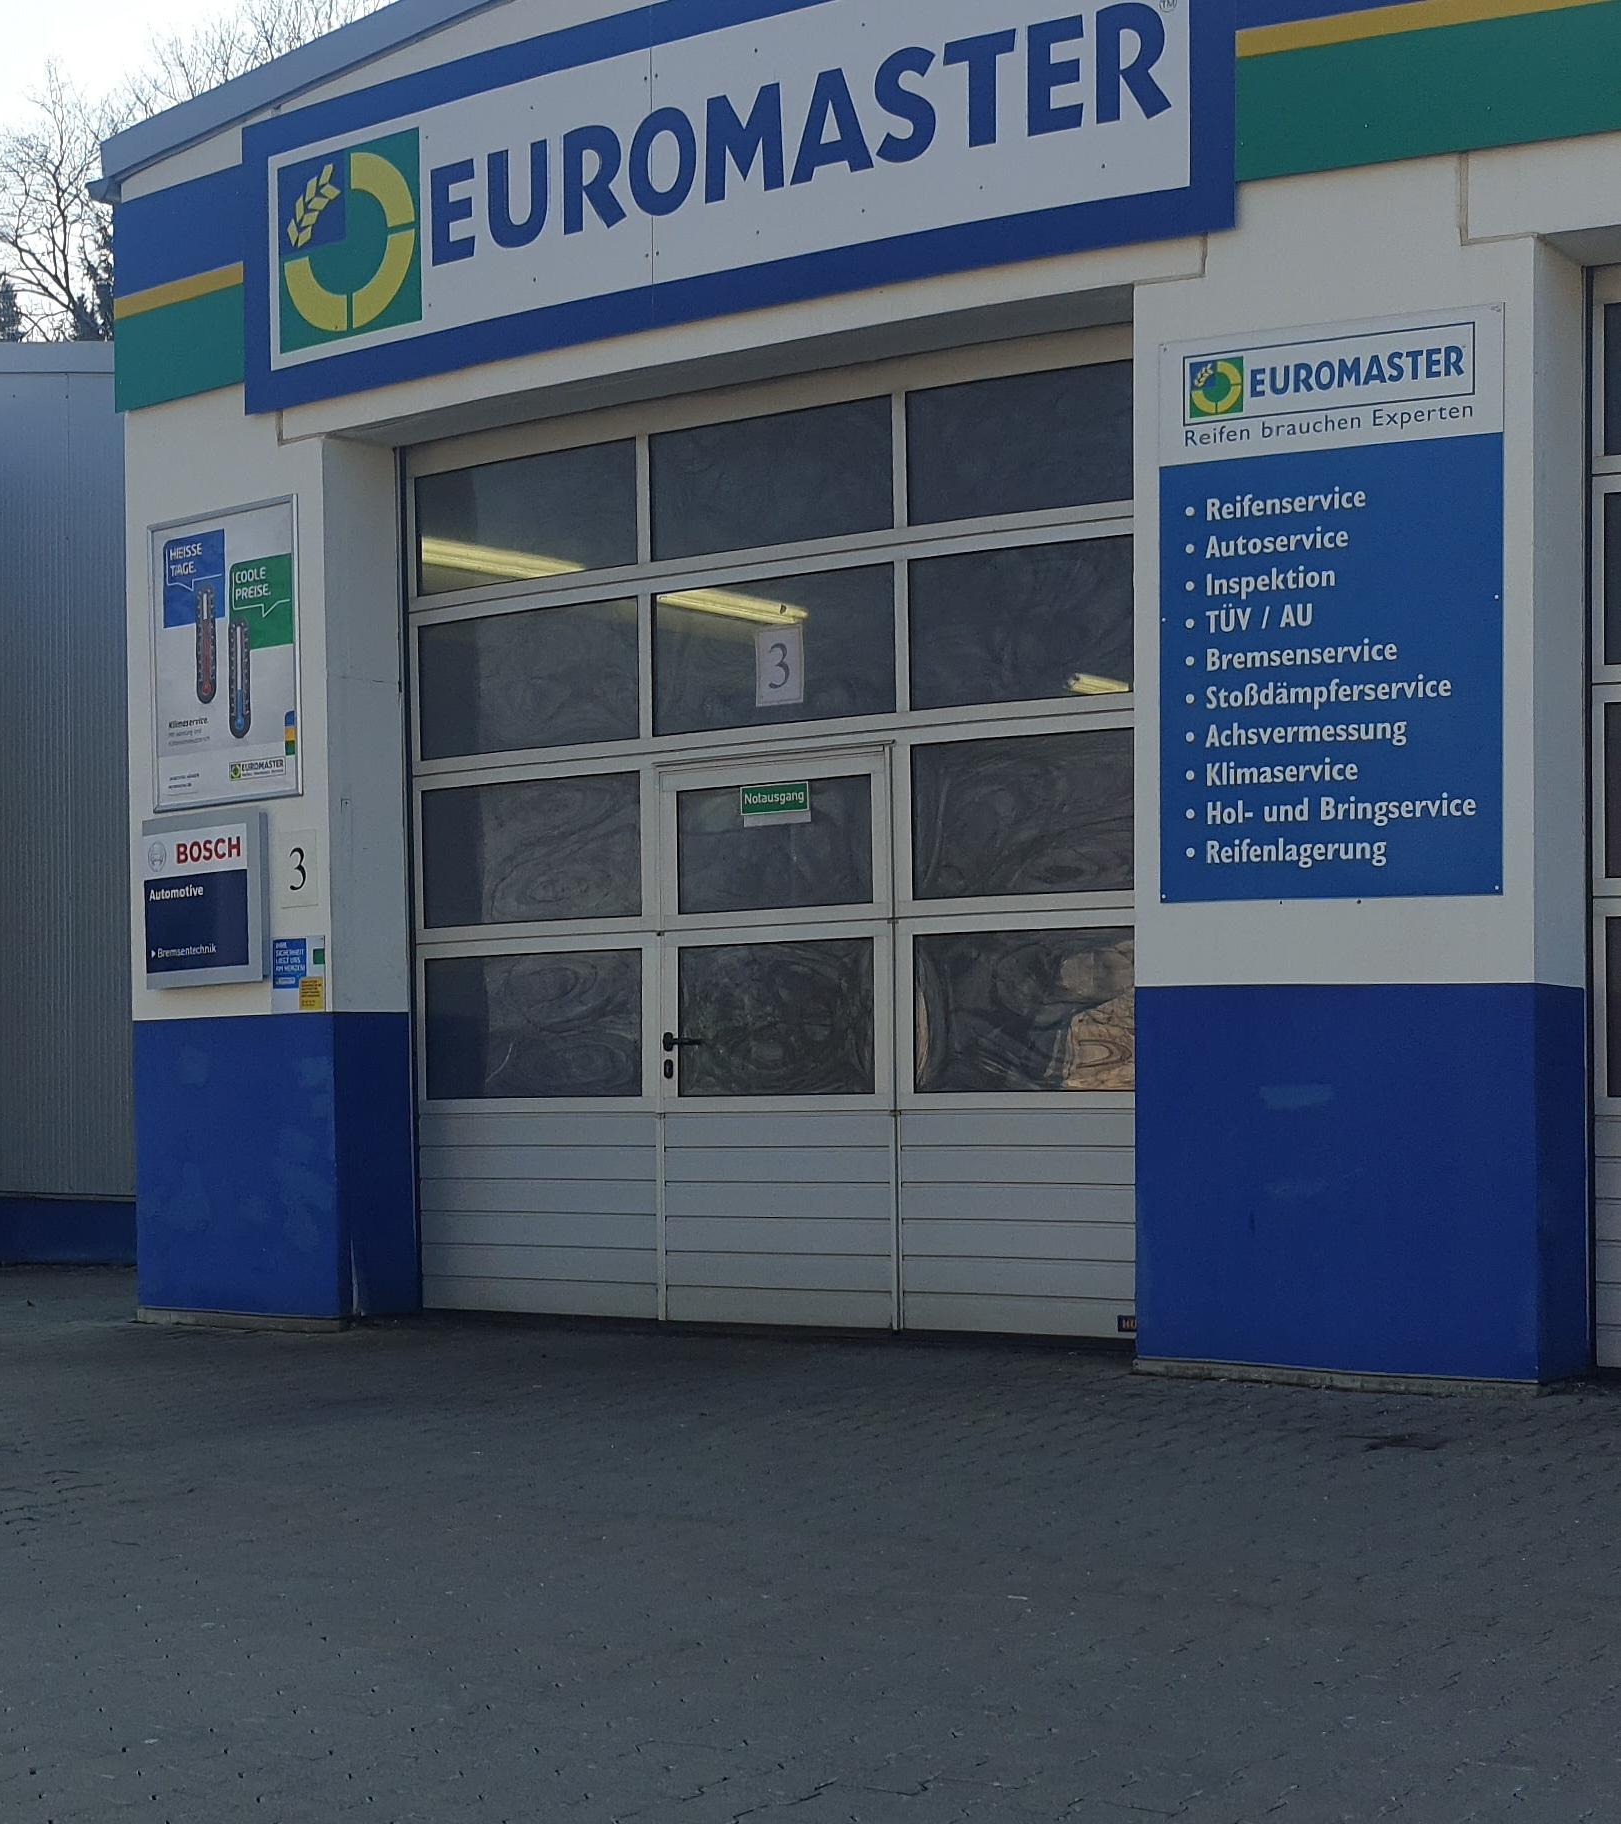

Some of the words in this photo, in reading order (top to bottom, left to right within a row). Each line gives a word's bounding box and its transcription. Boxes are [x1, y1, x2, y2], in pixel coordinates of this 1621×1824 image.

[431, 2, 1172, 268] EUROMASTER
[1250, 345, 1466, 398] EUROMASTER
[1184, 424, 1251, 447] Reifen
[1262, 413, 1361, 439] brauchen
[1372, 404, 1474, 429] Experten
[1206, 486, 1366, 521] Reifenservice
[170, 543, 202, 560] HEISSE
[1205, 526, 1349, 559] Autoservice
[170, 561, 196, 577] TAGE.
[235, 566, 266, 584] COOLE
[1206, 565, 1336, 599] Inspektion
[235, 583, 271, 600] PREISE.
[1206, 603, 1251, 634] TÜV
[1279, 603, 1313, 628] AU
[768, 643, 790, 689] 3
[1206, 638, 1398, 672] Bremsenservice
[1206, 674, 1452, 710] Stoßdämpferservice
[1205, 720, 1407, 748] Achsvermessung
[1206, 757, 1359, 786] Klimaservice
[744, 790, 805, 806] Notausgang
[1207, 800, 1253, 825] Hol-
[1263, 797, 1309, 822] und
[1320, 792, 1477, 827] Bringservice
[175, 836, 241, 864] BOSCH
[1206, 838, 1387, 868] Reifenlagerung
[289, 847, 307, 891] 3
[149, 884, 204, 901] Automotive
[157, 943, 217, 959] Bremsentechnik
